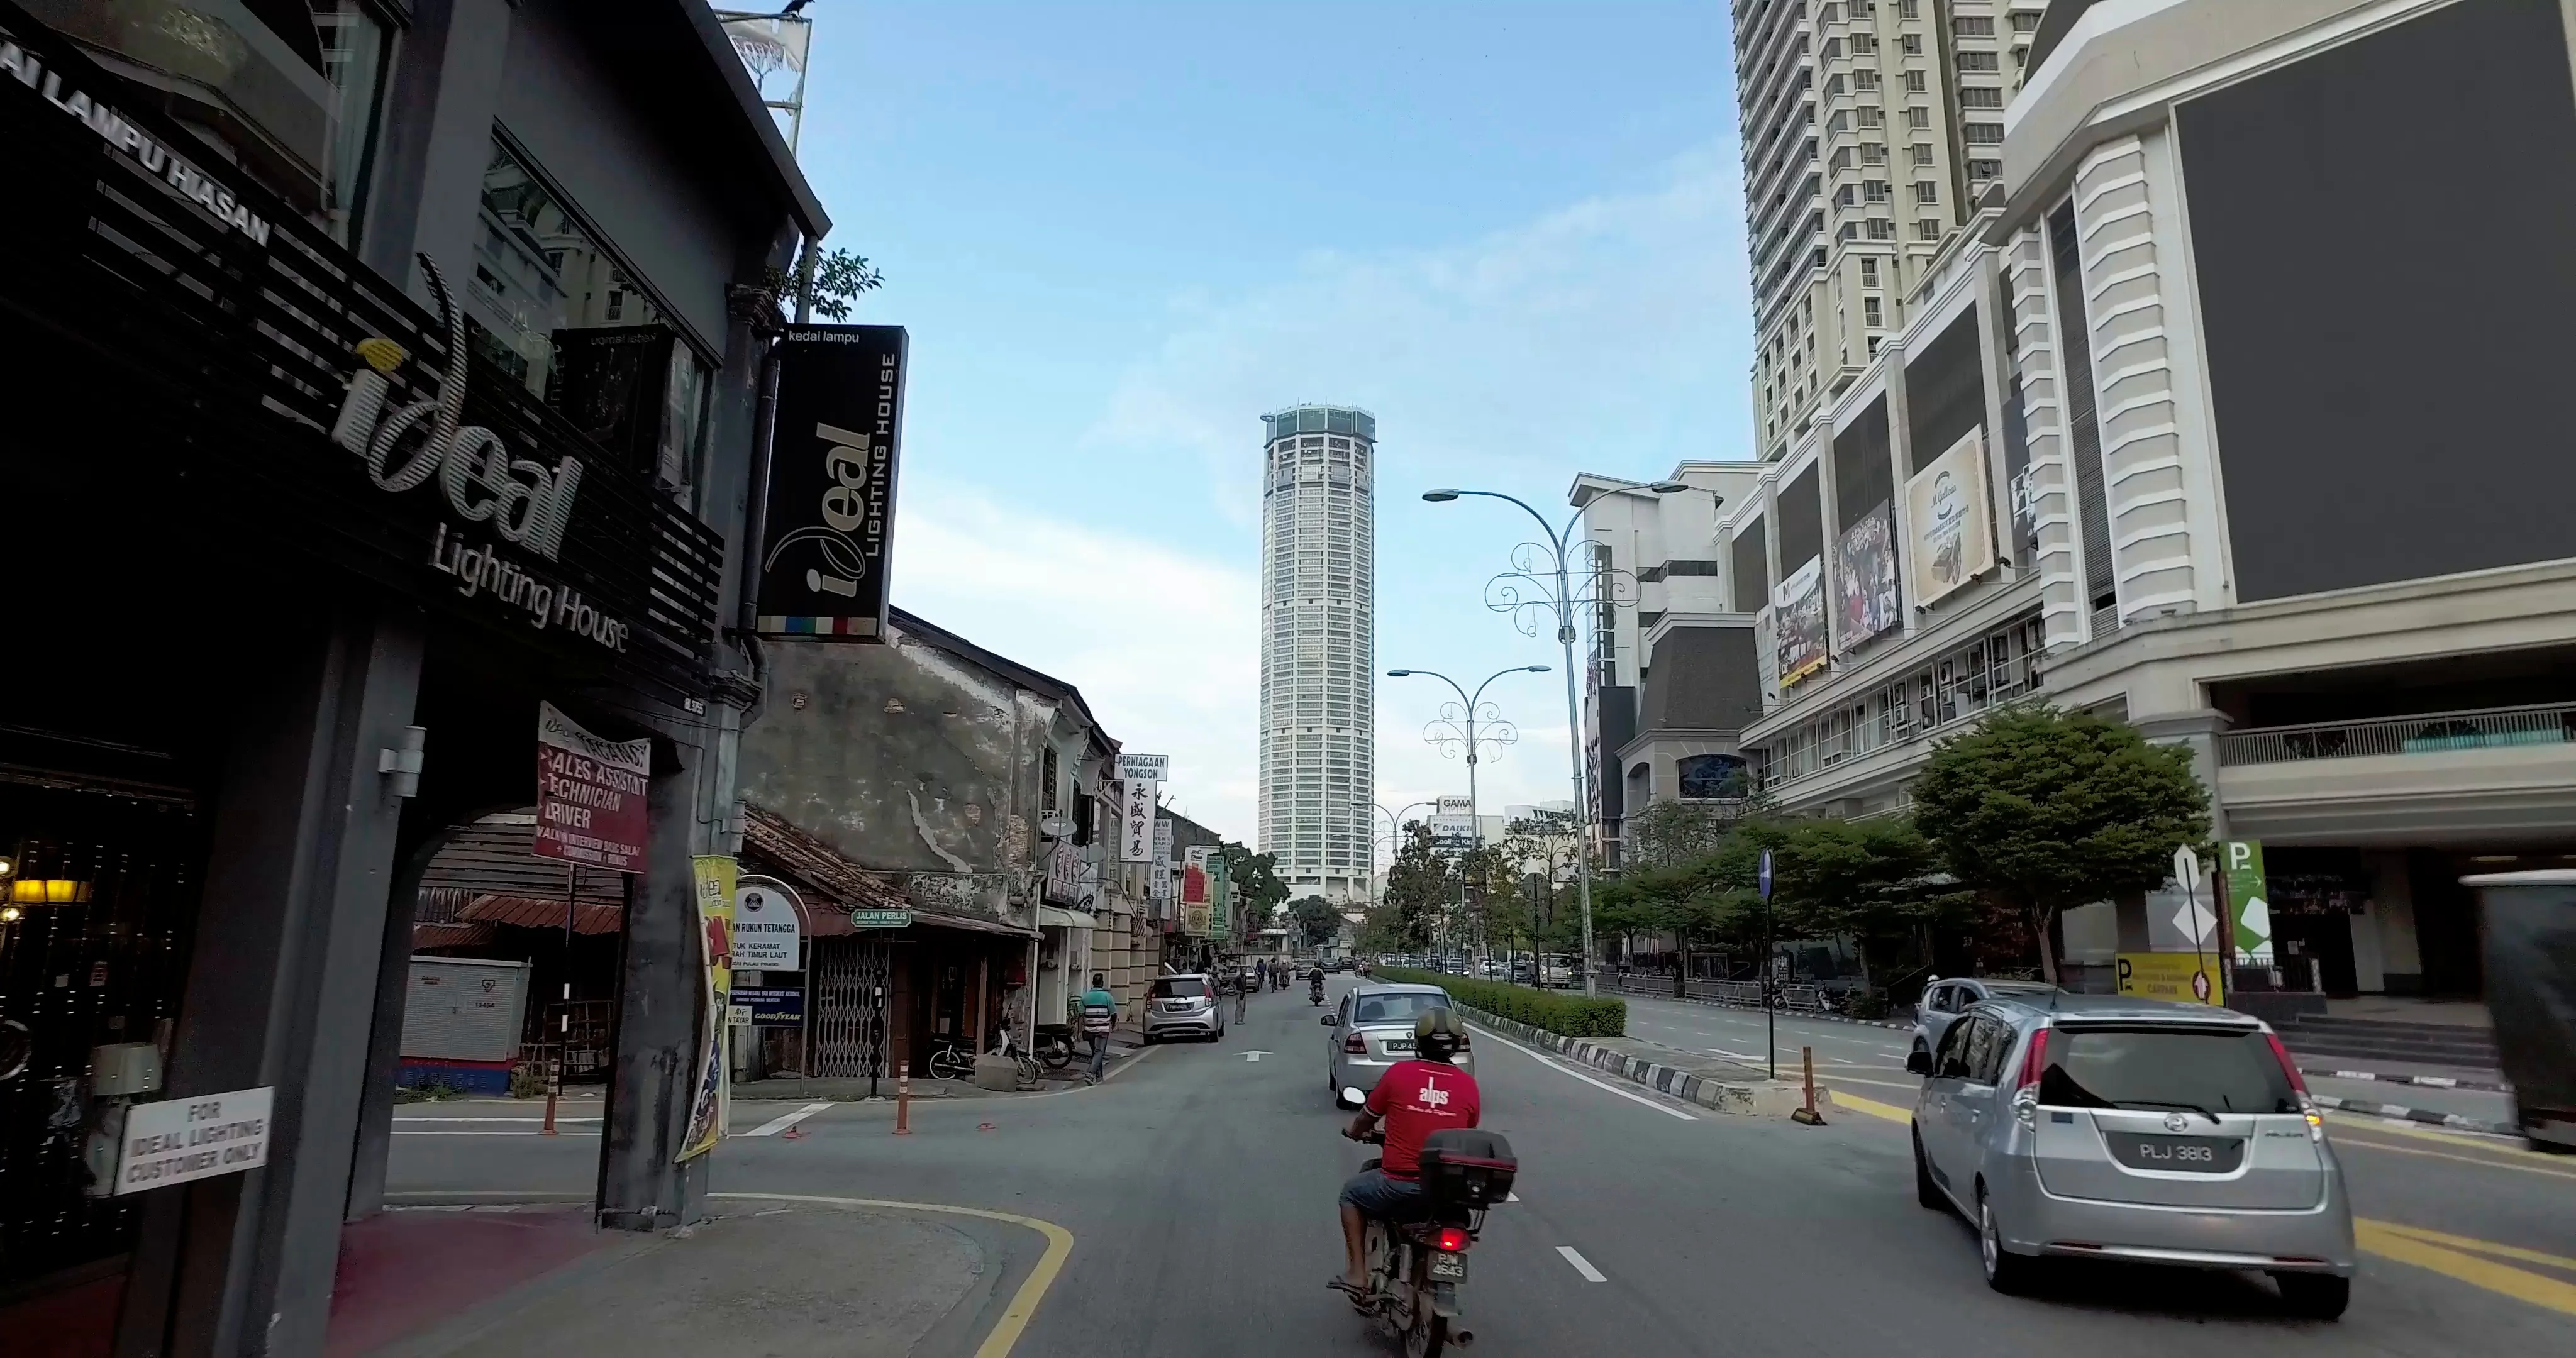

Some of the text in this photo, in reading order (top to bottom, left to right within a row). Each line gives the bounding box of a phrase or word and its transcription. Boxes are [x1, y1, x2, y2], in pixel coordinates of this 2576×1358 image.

[42, 70, 165, 173] LAMPU
[167, 157, 270, 247] HIASAN
[789, 330, 860, 345] kedai lampu
[865, 353, 896, 558] LIGHTING HOUSE
[432, 522, 630, 654] Lighting House
[1118, 756, 1165, 768] PERNIAGAAN
[1124, 768, 1158, 779] YONGSON
[1443, 799, 1472, 807] GAMA
[2229, 842, 2251, 870] P
[741, 923, 762, 933] RUKUN
[763, 924, 795, 934] TETANGGA
[755, 1012, 801, 1021] GOODYEAR
[1419, 1076, 1450, 1108] alps
[187, 1101, 222, 1123] FOR
[131, 1118, 264, 1158] IDEAL LIGHTING
[126, 1141, 263, 1184] CUSTOMER ONLY
[2140, 1144, 2212, 1161] PLJ 3813
